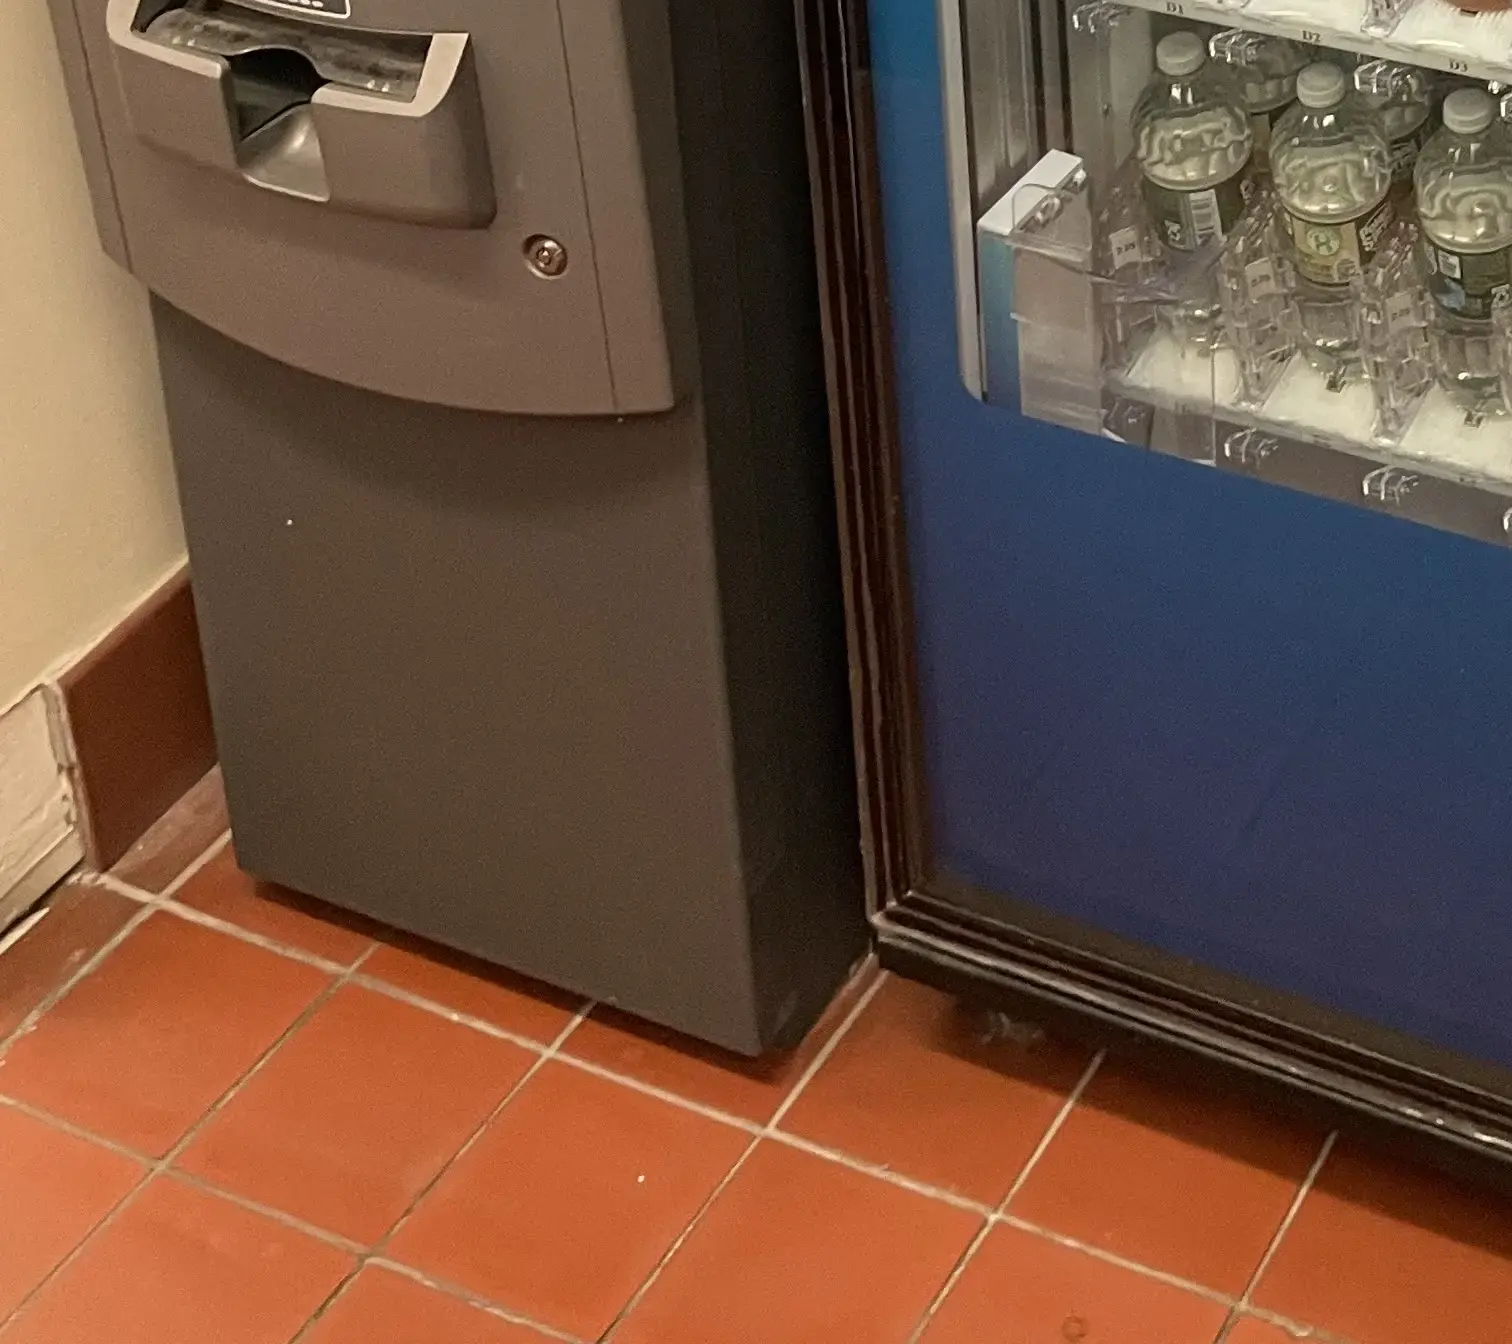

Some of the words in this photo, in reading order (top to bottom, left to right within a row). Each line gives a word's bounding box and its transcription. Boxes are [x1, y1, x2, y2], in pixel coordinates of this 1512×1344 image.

[1166, 2, 1184, 15] D1
[1302, 30, 1322, 43] D2
[1449, 60, 1468, 73] D3
